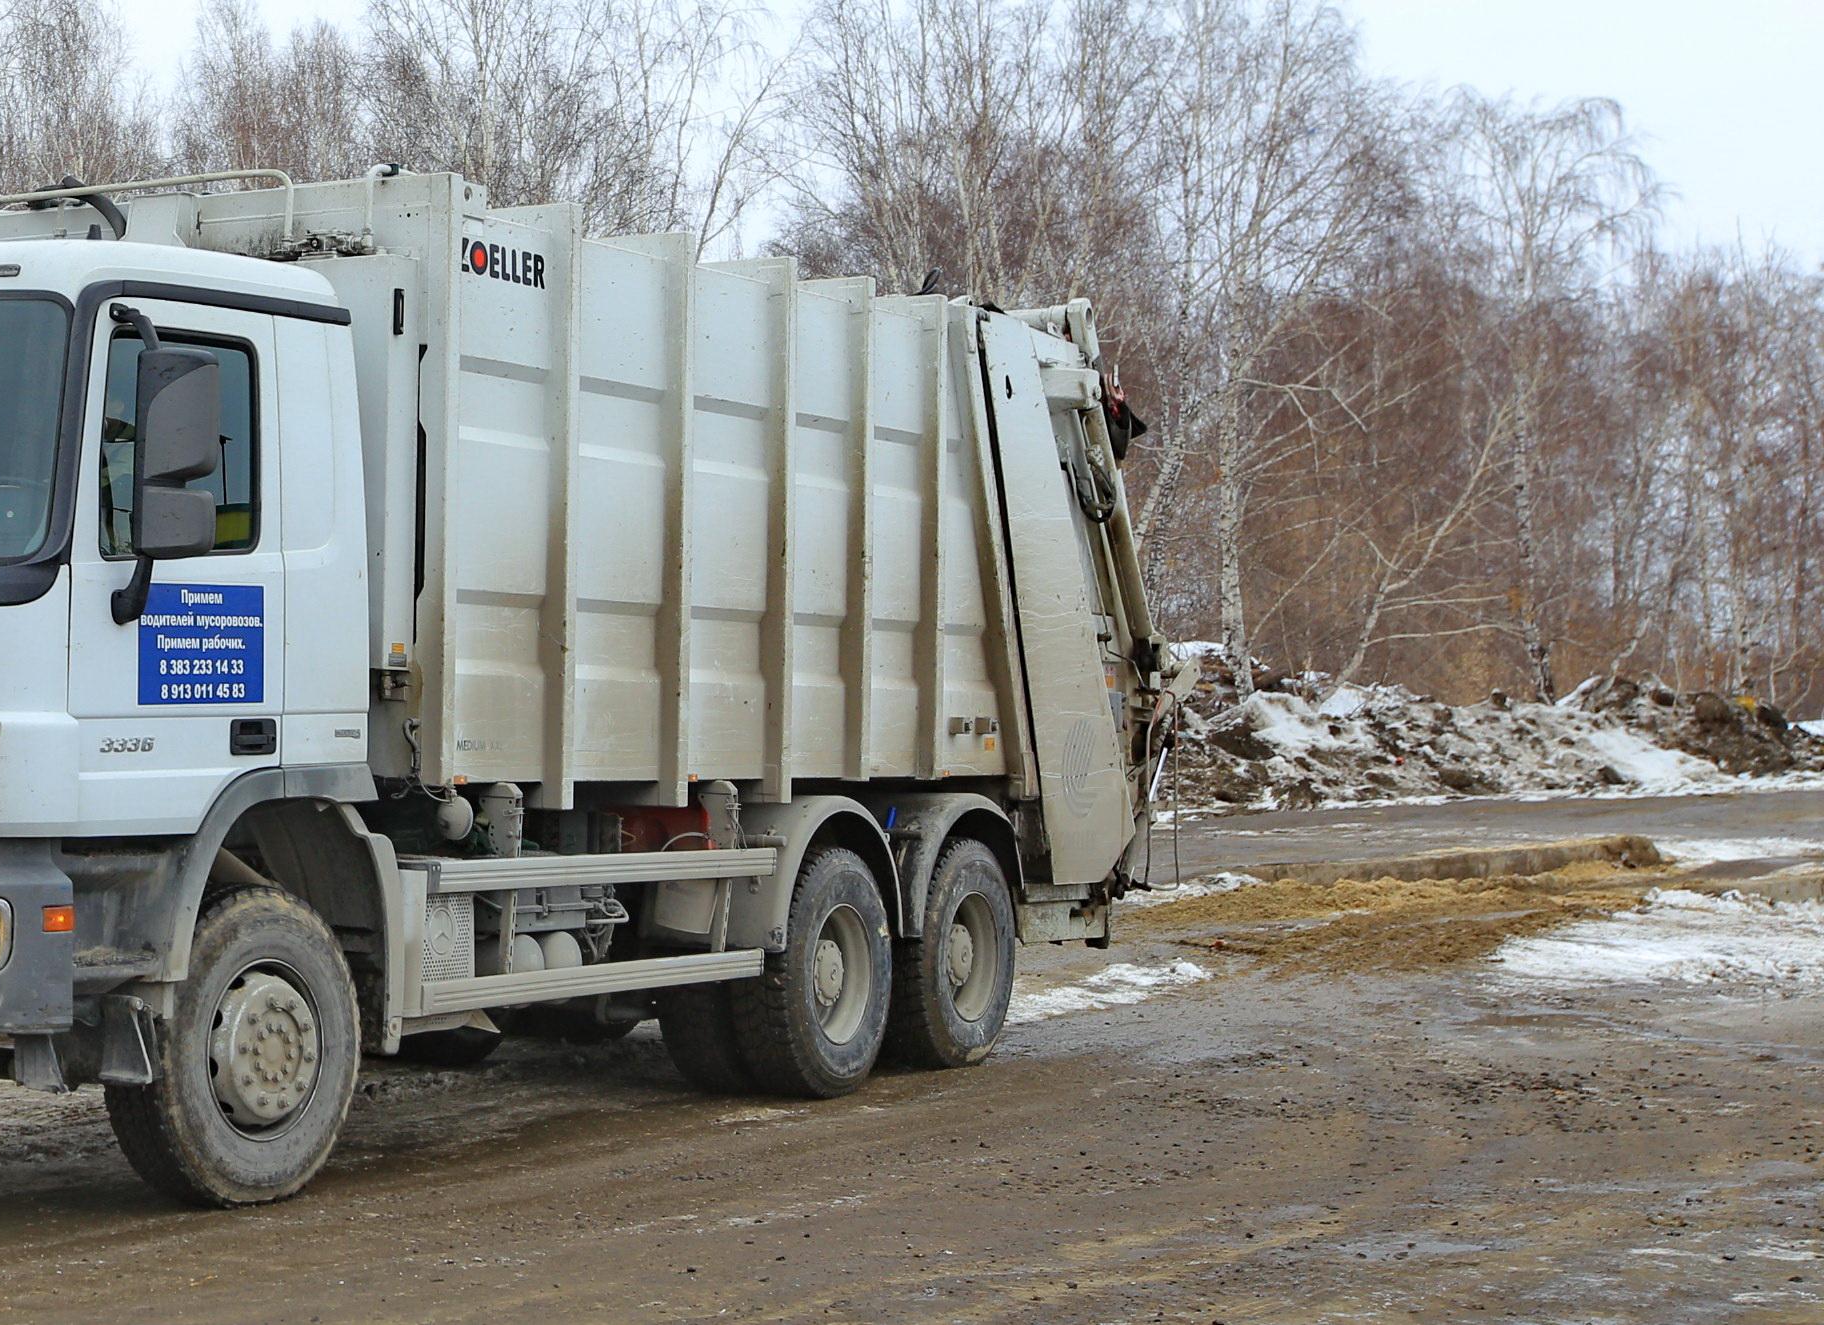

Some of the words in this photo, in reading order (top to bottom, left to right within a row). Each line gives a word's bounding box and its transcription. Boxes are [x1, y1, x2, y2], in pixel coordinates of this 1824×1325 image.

[180, 589, 223, 607] Примем
[140, 611, 194, 628] водителей
[196, 616, 263, 630] мусоровозов.
[157, 634, 200, 652] Примем
[202, 634, 246, 652] рабочих.
[159, 659, 167, 675] 8
[169, 659, 190, 675] 383
[192, 659, 213, 675] 233
[215, 659, 229, 674] 14
[230, 659, 244, 674] 33
[160, 683, 169, 699] 8
[170, 683, 192, 699] 913
[194, 683, 213, 699] 011
[216, 683, 230, 698] 45
[231, 683, 245, 698] 83
[99, 737, 155, 753] 3336
